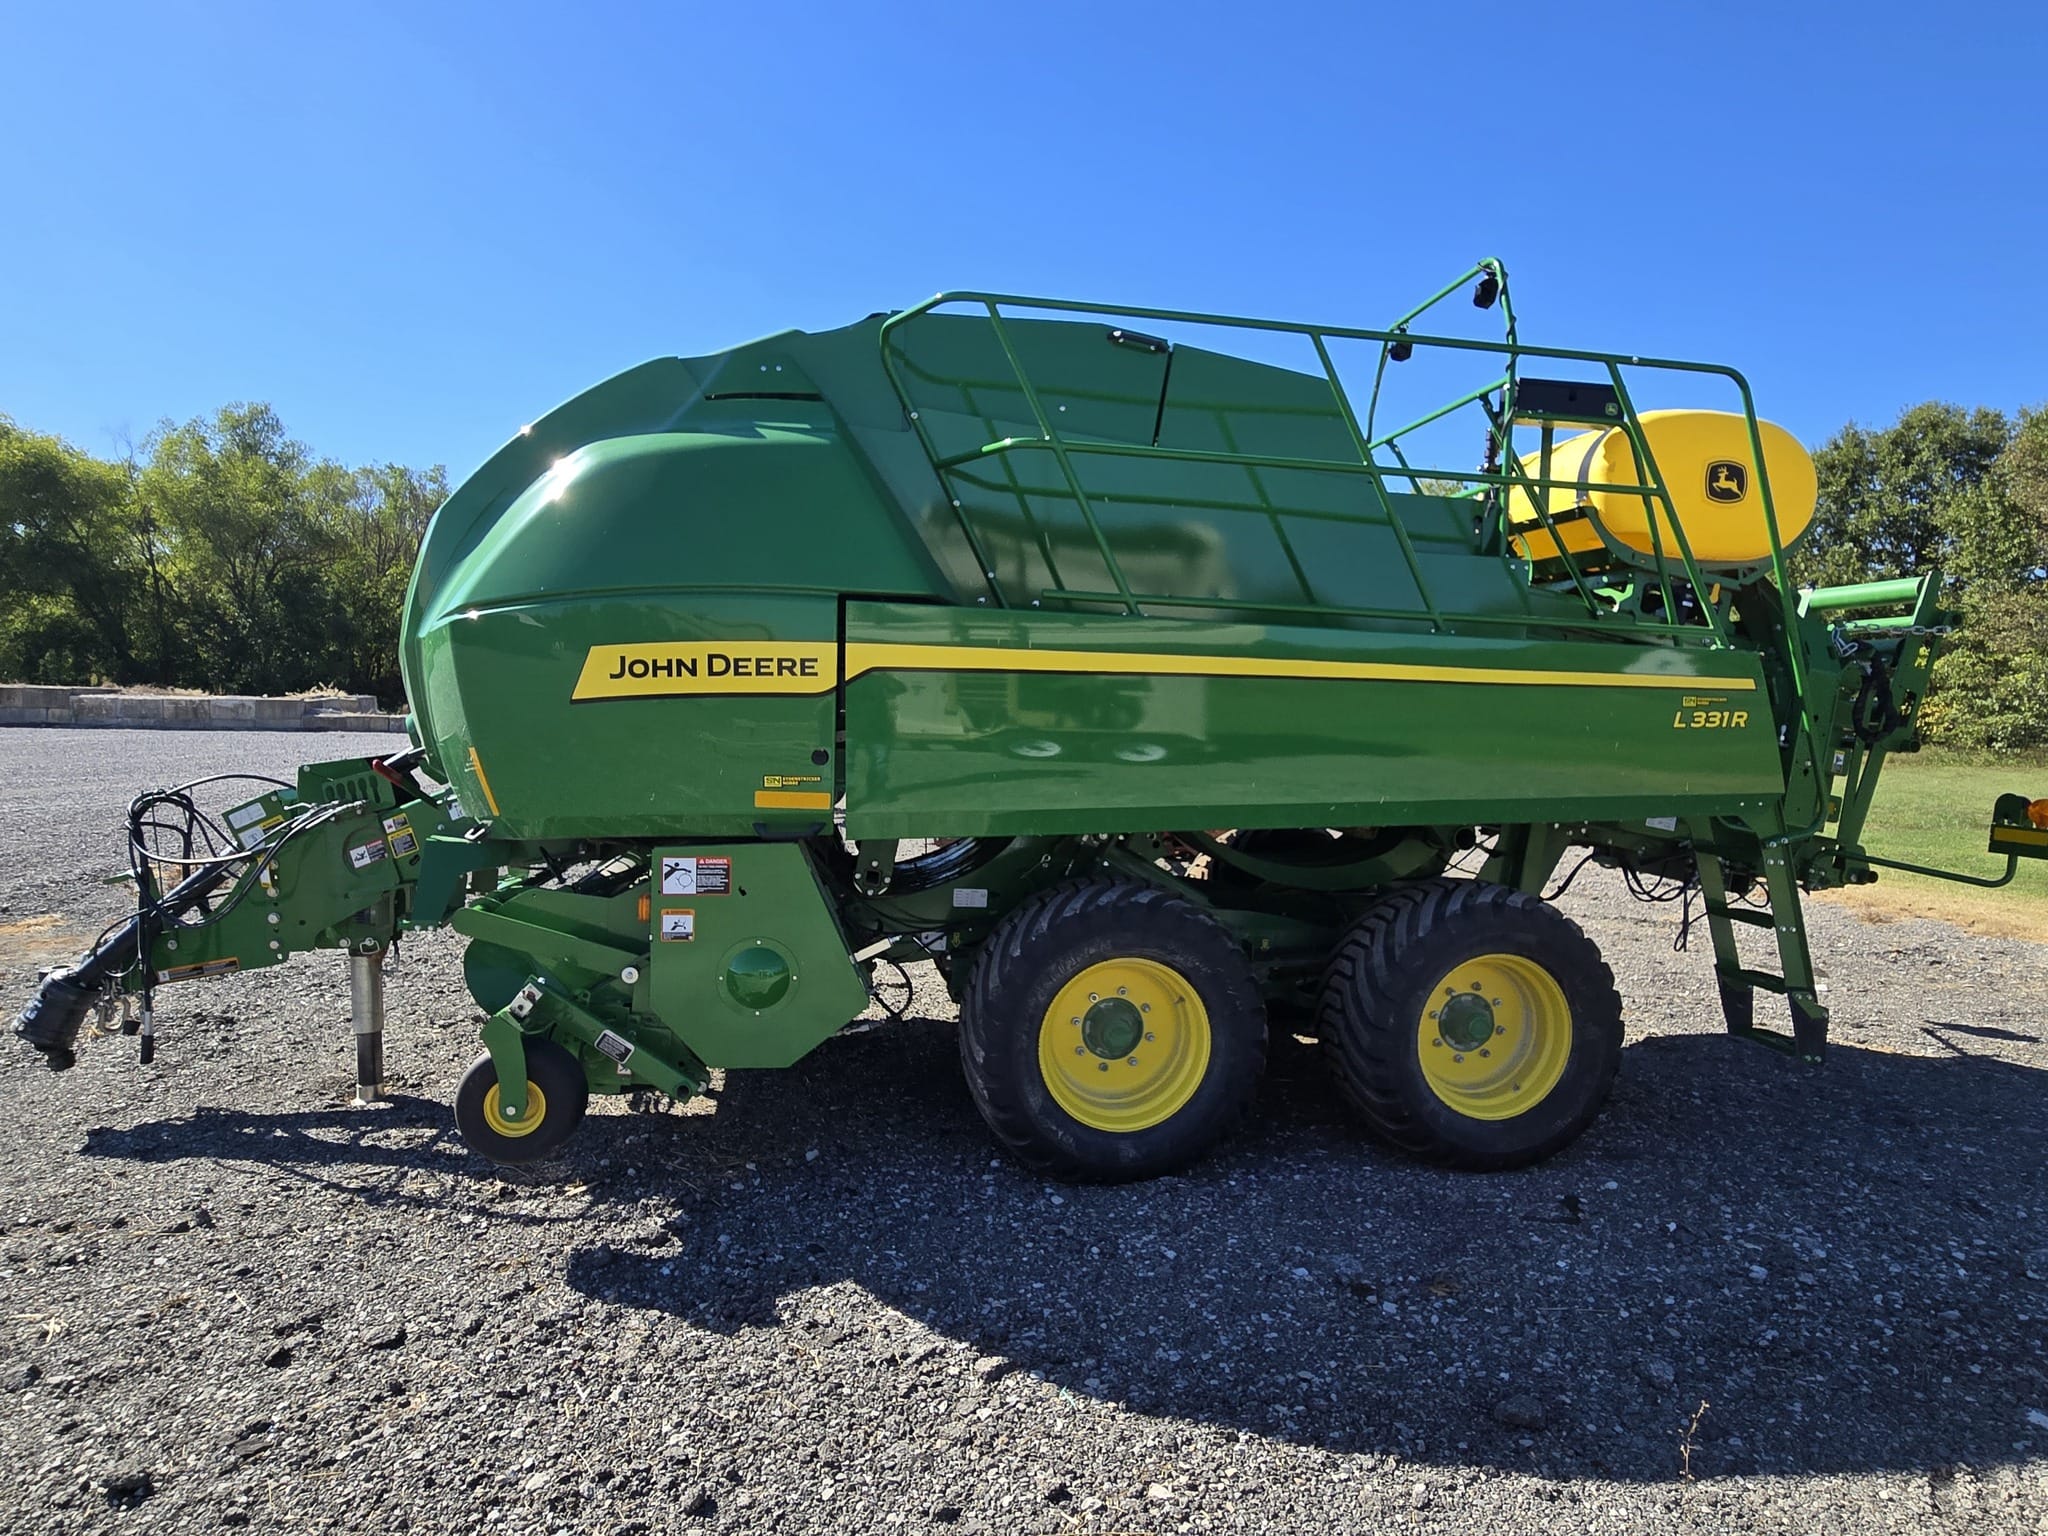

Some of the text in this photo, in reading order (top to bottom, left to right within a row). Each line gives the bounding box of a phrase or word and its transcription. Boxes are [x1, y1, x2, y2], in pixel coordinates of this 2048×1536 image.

[609, 653, 819, 680] JOHN DEERE
[1673, 711, 1748, 728] L331R
